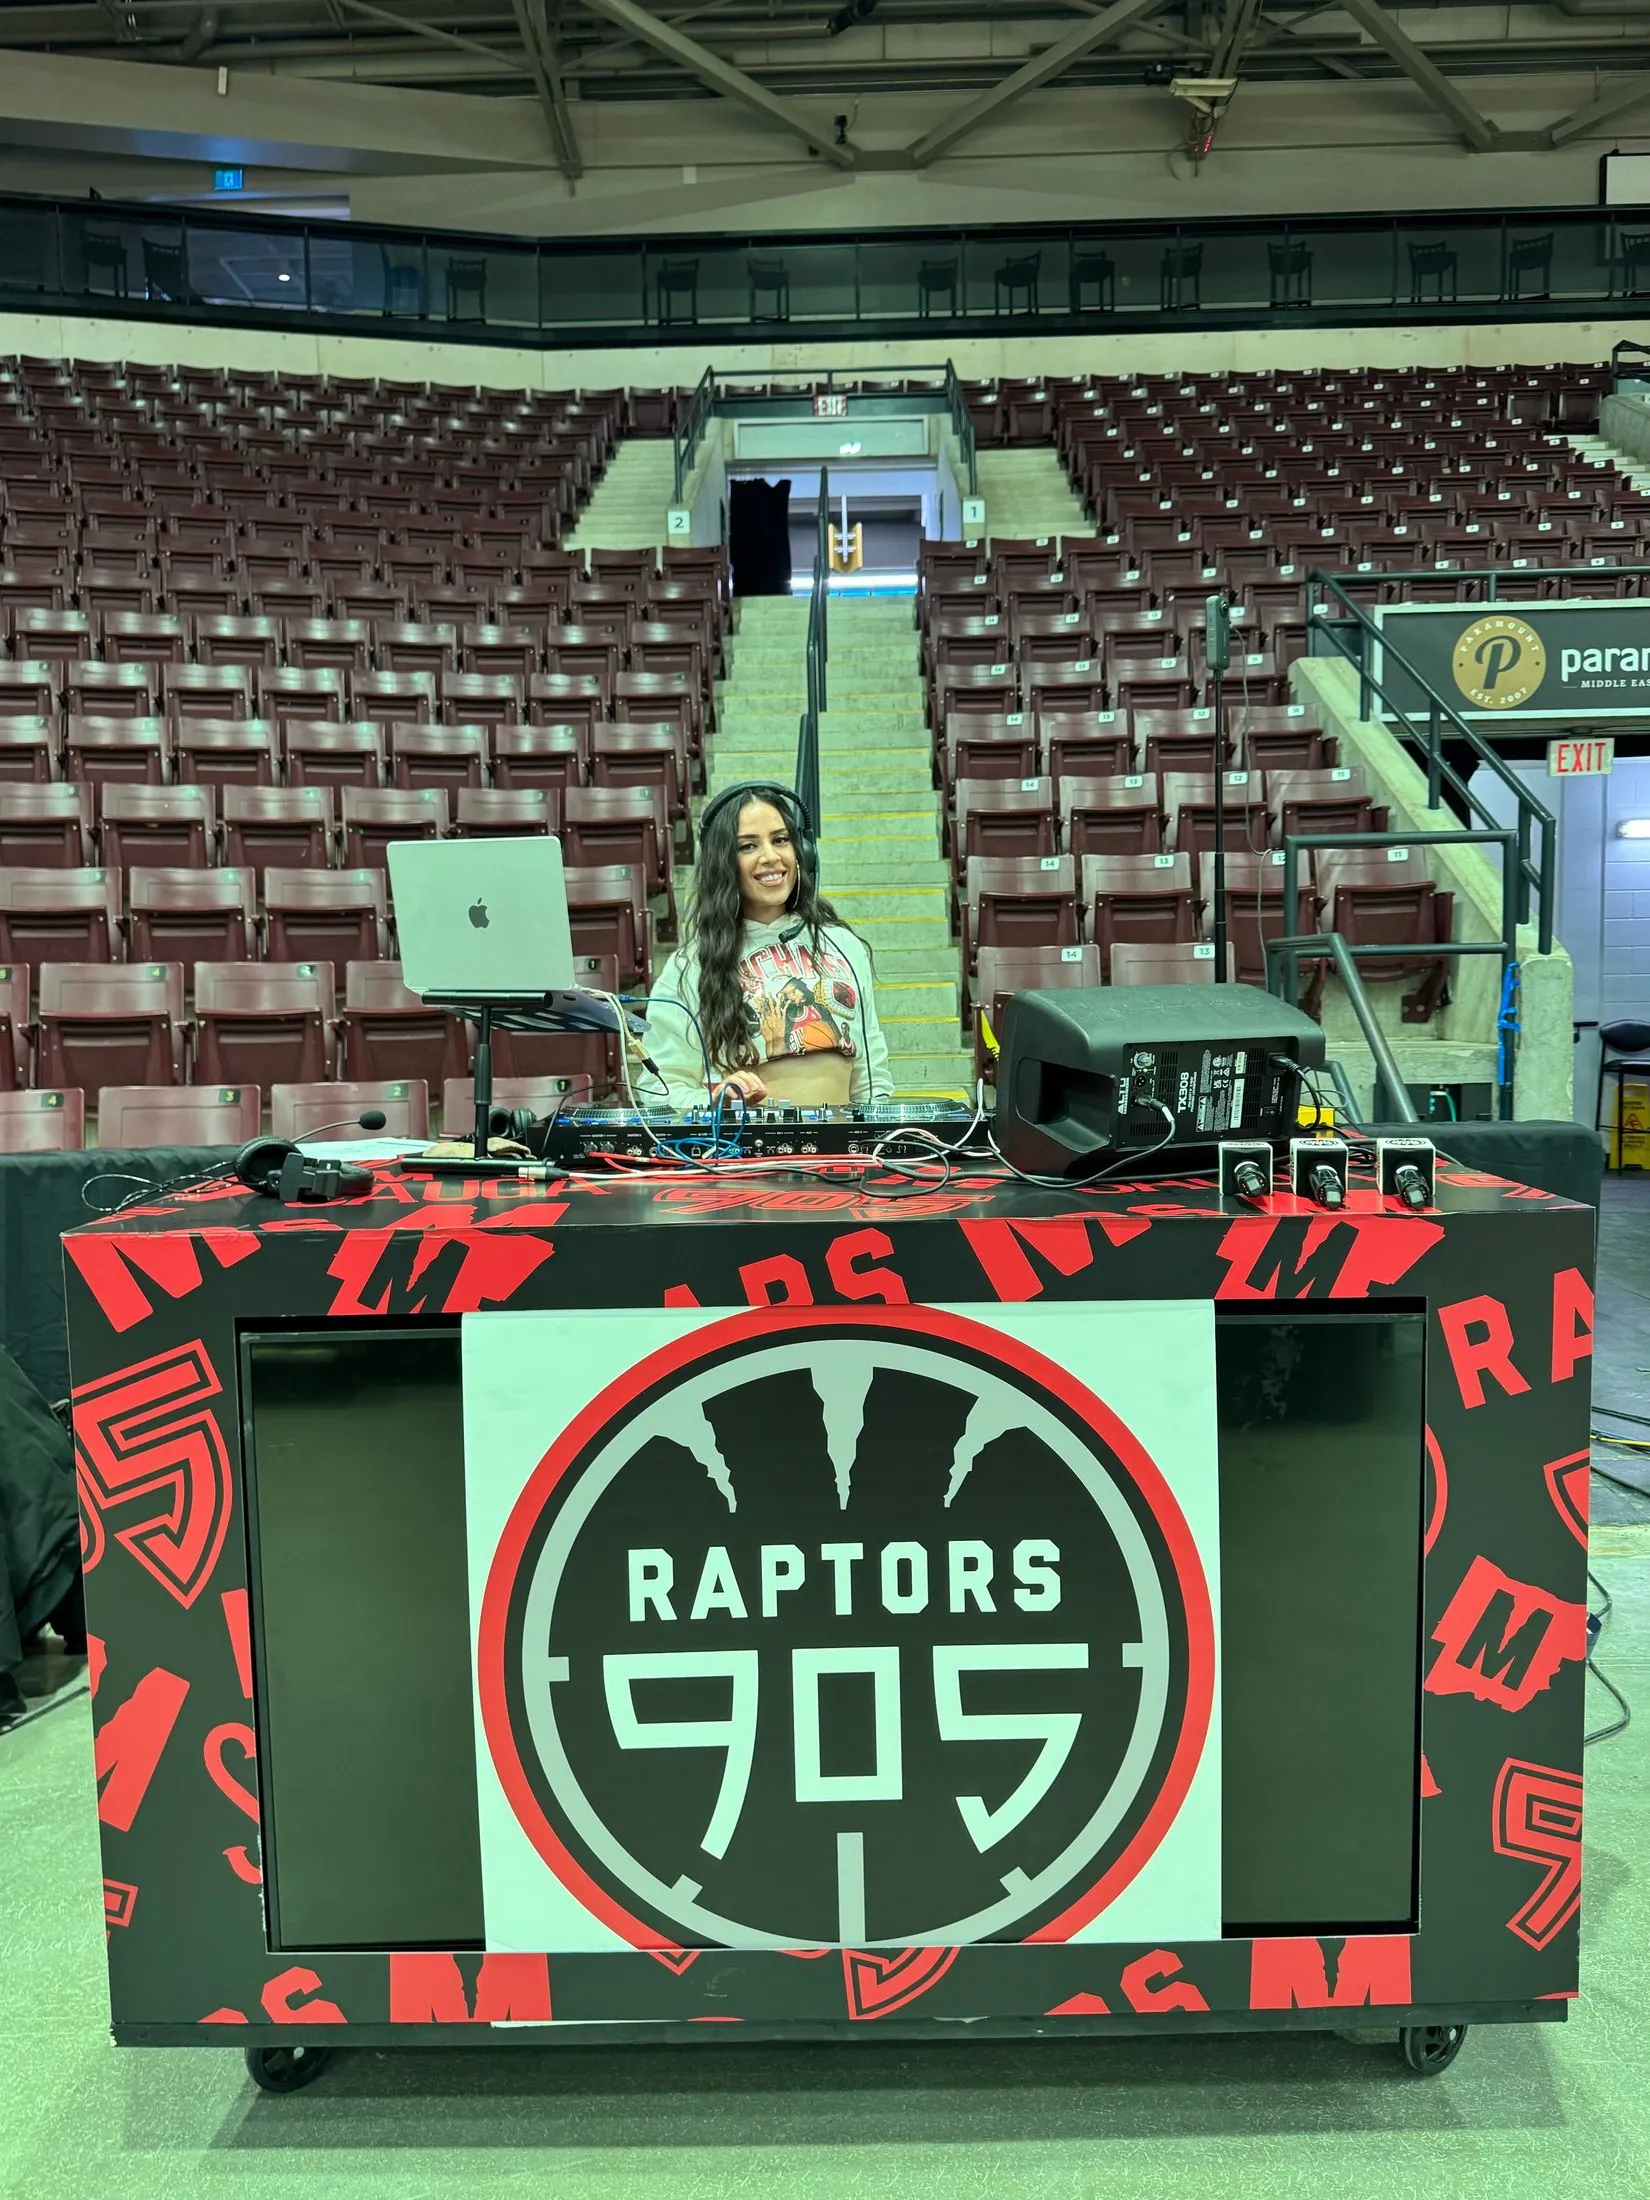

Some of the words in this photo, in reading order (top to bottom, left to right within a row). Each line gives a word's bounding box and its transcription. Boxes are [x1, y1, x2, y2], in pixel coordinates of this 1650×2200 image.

[674, 516, 684, 529] 2
[970, 506, 978, 518] 1
[1459, 619, 1540, 654] PARAMOUNT
[1474, 635, 1522, 690] P
[1499, 686, 1528, 704] 2007
[1580, 679, 1627, 689] MIDDLE
[1557, 742, 1607, 773] EXIT
[1066, 950, 1077, 959] 14
[1199, 947, 1210, 956] 13
[1177, 1071, 1190, 1114] TX308
[627, 1538, 1062, 1623] RAPTORS
[602, 1642, 1090, 1861] 905
